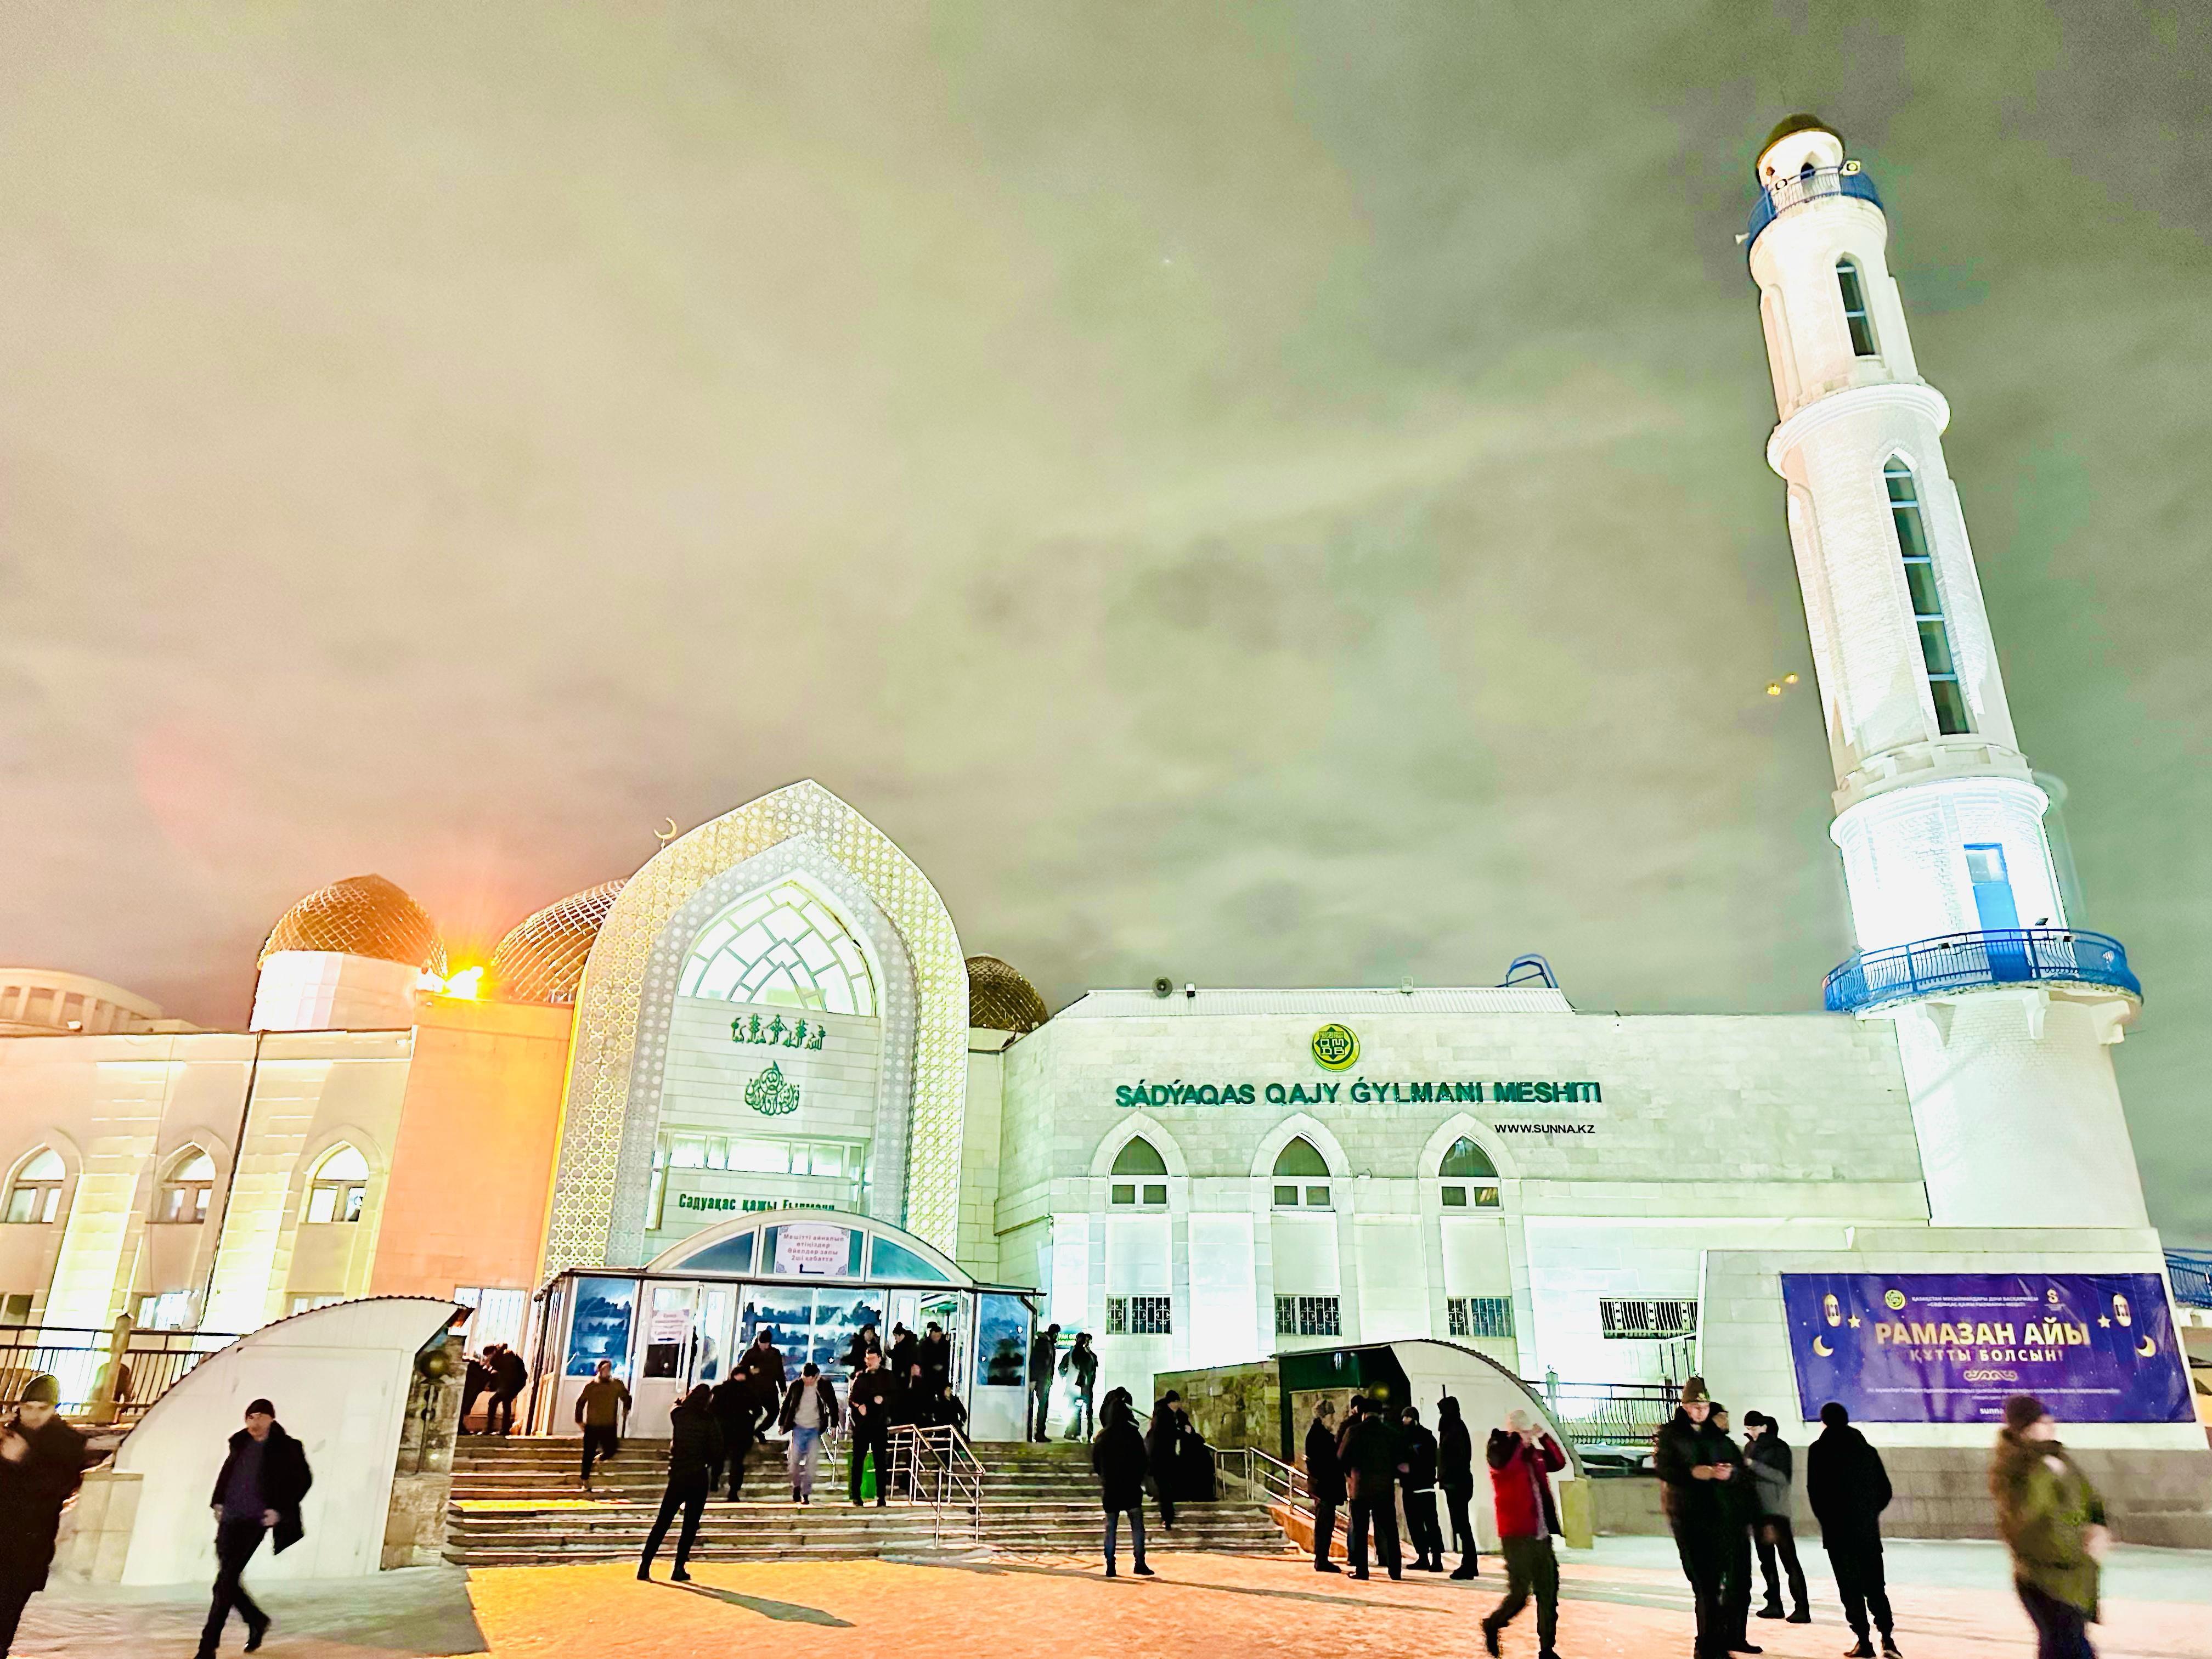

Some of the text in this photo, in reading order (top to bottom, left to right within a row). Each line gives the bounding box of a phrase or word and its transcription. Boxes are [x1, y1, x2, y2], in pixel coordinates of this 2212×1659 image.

[1115, 1079, 1256, 1107] SÁDÝAQAS
[1265, 1083, 1341, 1106] QAJY
[1493, 1082, 1602, 1104] MESHITI
[1494, 1124, 1596, 1135] WWW.SUNNA.KZ
[679, 1193, 737, 1211] Сәдуақас
[742, 1199, 777, 1212] қажы
[1875, 1316, 2091, 1346] РАМАЗАН АЙЫ
[1910, 1350, 2063, 1363] ҚҰТТЫ БОЛСЫН!
